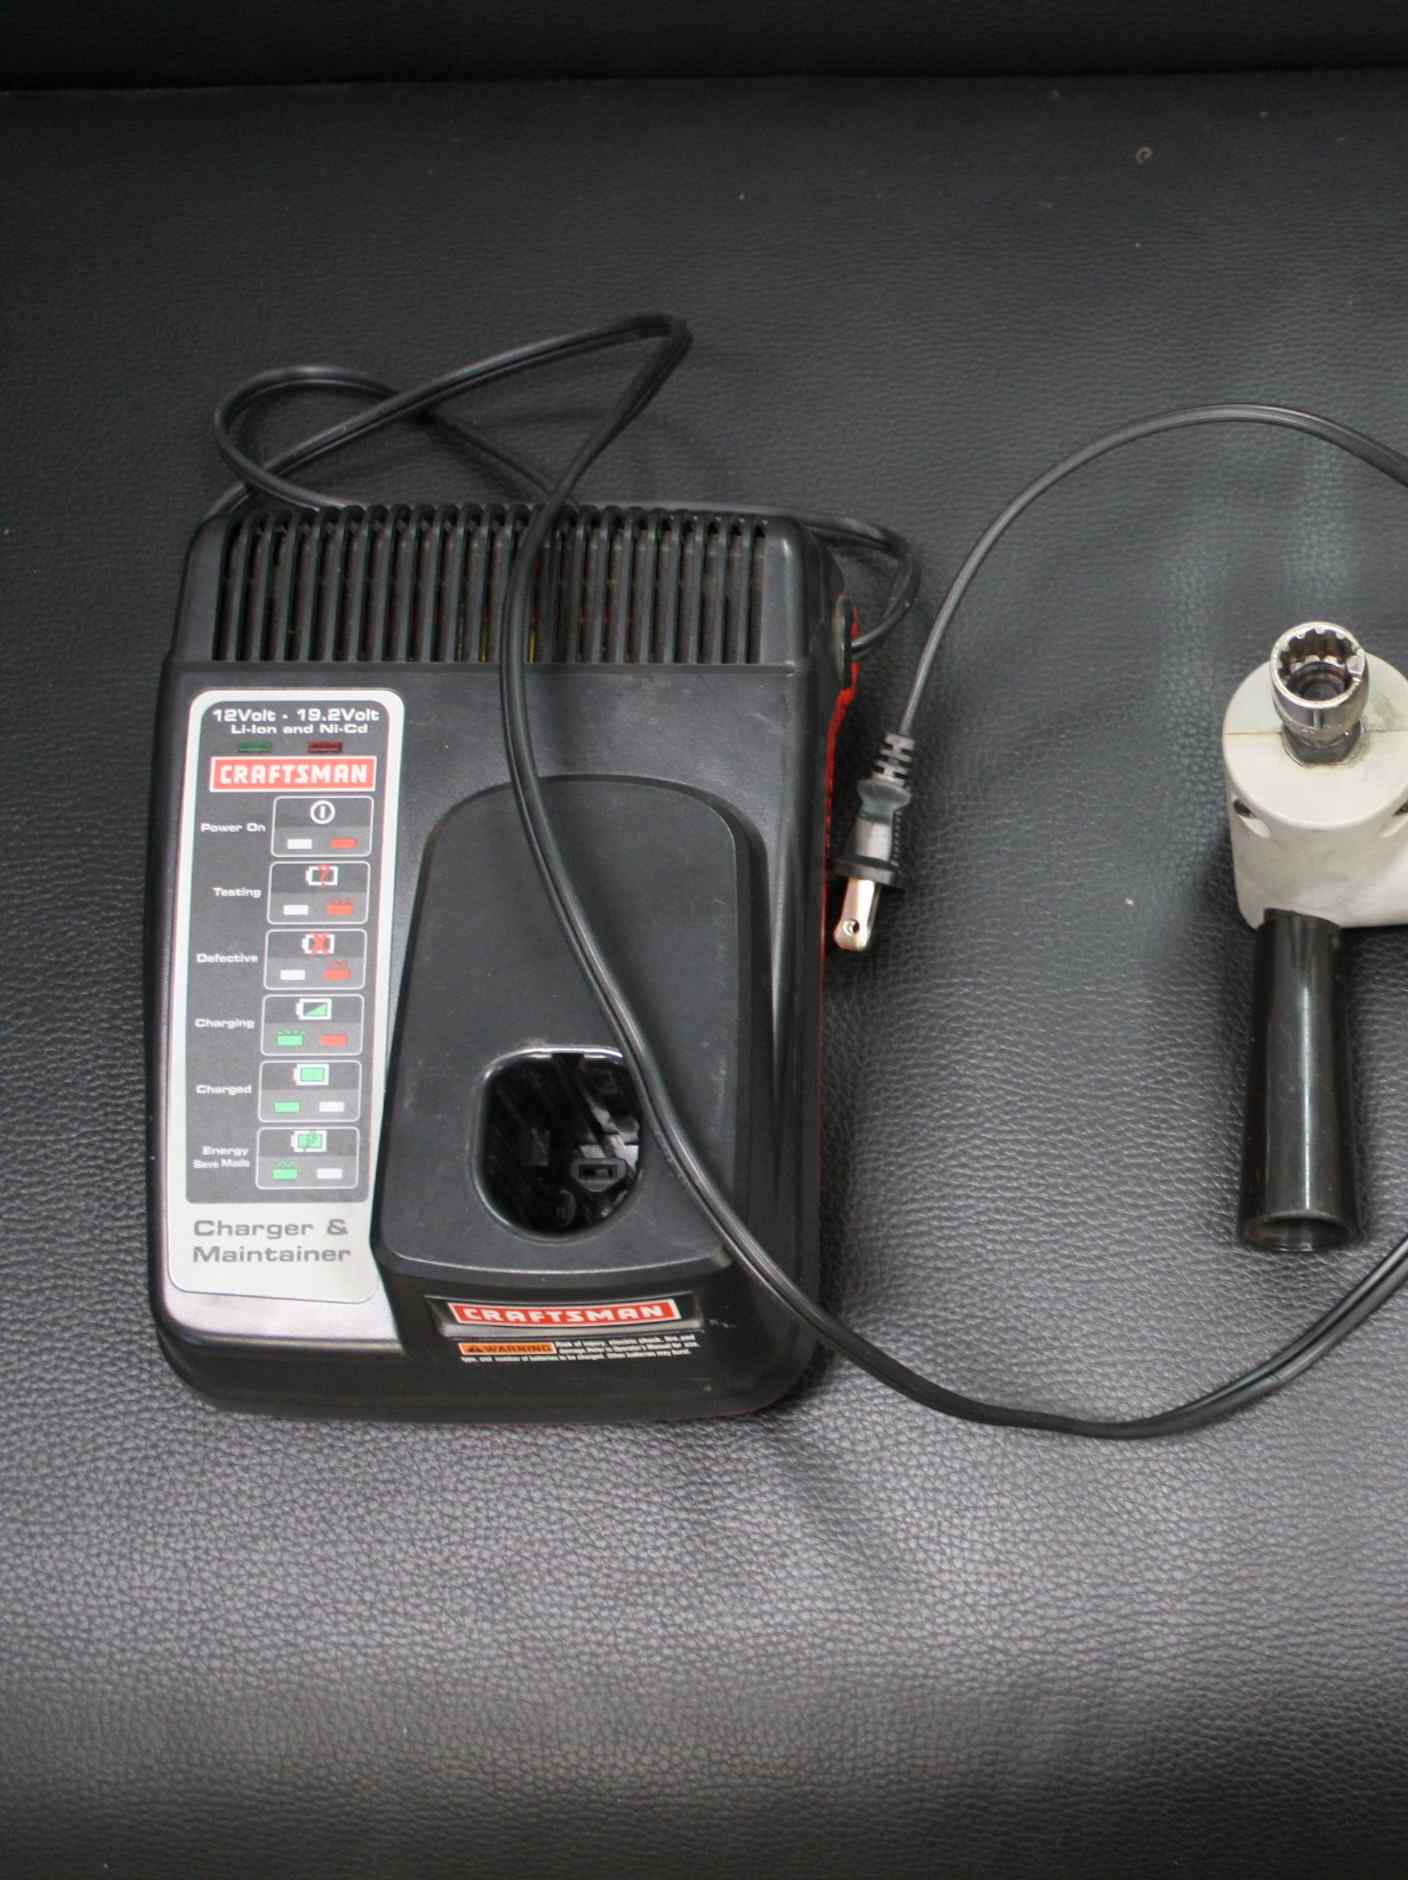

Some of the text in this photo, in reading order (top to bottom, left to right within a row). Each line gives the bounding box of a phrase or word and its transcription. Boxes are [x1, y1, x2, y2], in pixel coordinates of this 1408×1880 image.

[213, 708, 380, 722] 12Volt 19.2Volt
[231, 724, 369, 735] Li-Ion and Ni-Cd
[220, 764, 368, 785] CRAFTSMAN
[200, 822, 266, 833] Power On
[212, 887, 262, 898] Testing
[196, 953, 258, 964] Defective
[194, 1018, 255, 1030] Charging
[195, 1084, 252, 1096] Charged
[202, 1146, 249, 1157] Energy
[220, 1158, 251, 1168] Mode
[193, 1218, 349, 1240] Charger &
[192, 1245, 352, 1263] Maintainer
[462, 1304, 665, 1323] CRAFTSMAN
[485, 1344, 551, 1353] WARNING
